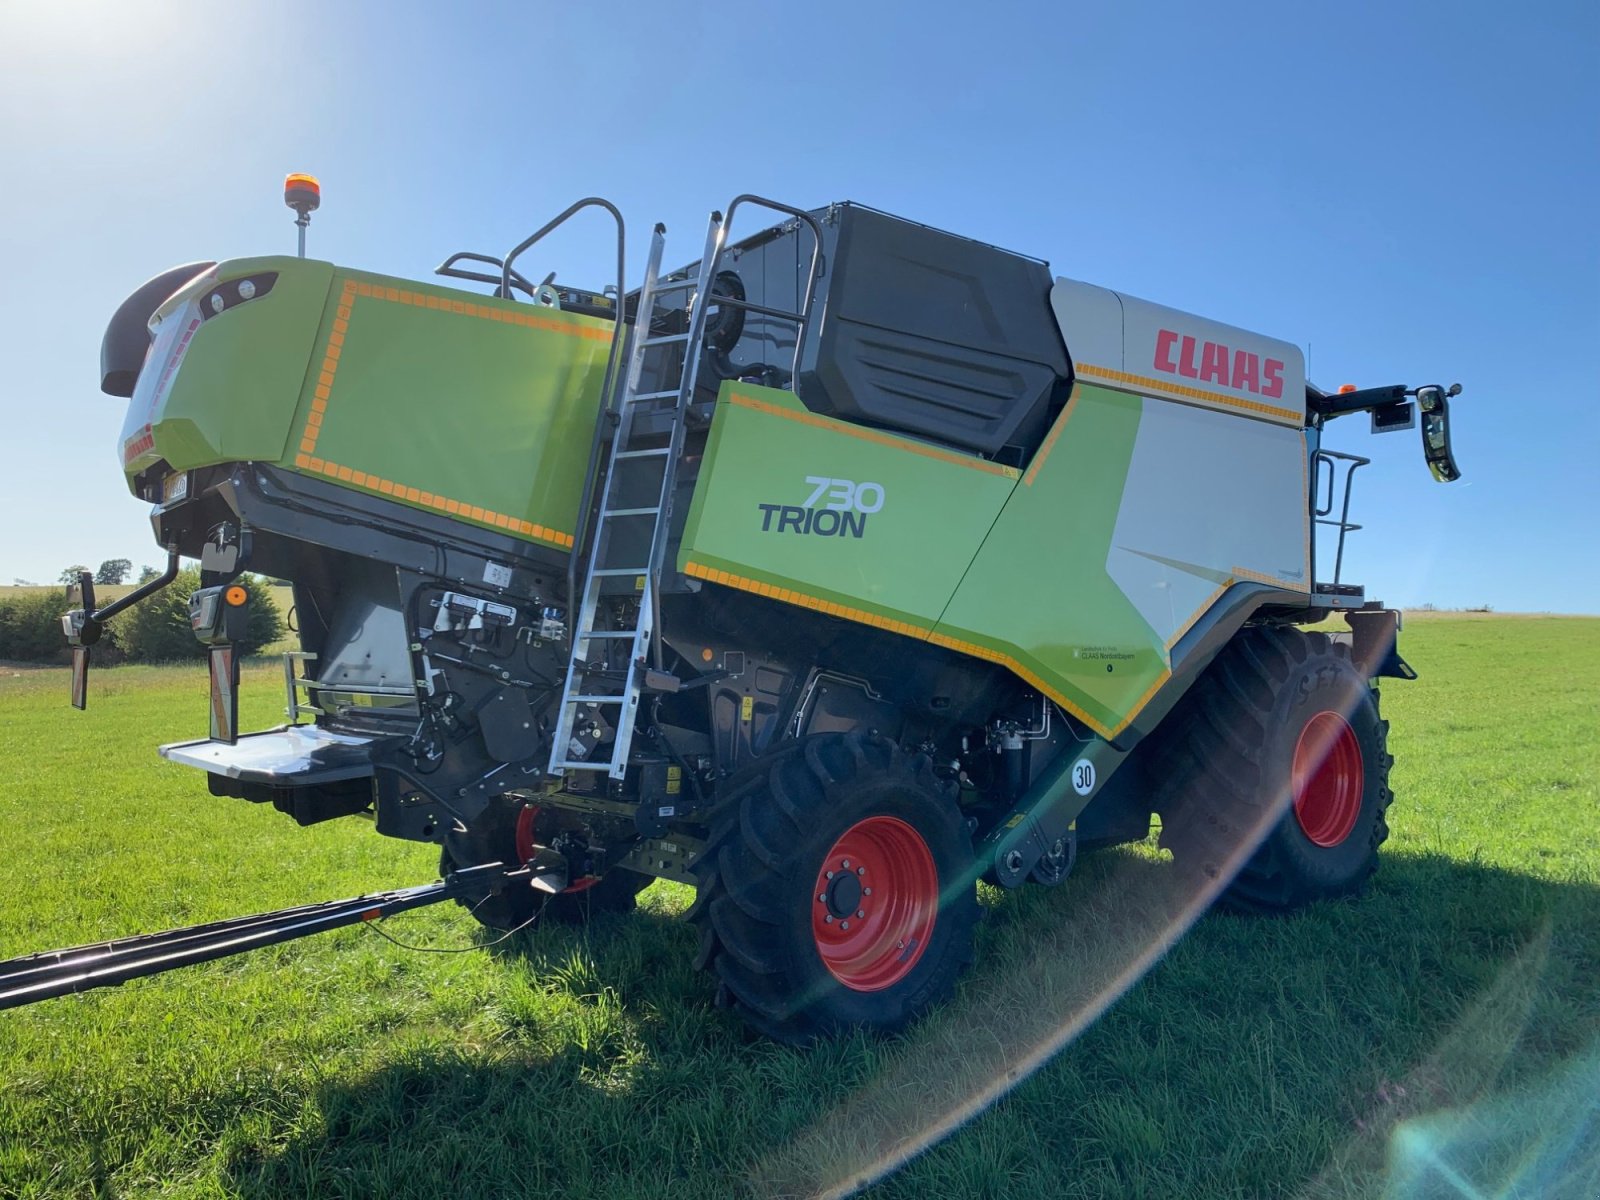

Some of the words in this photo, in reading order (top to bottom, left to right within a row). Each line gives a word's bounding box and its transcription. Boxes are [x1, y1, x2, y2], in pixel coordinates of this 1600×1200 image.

[1154, 328, 1284, 399] CLAAS
[803, 476, 885, 513] 730
[759, 504, 866, 538] TRION
[1075, 765, 1091, 788] 30
